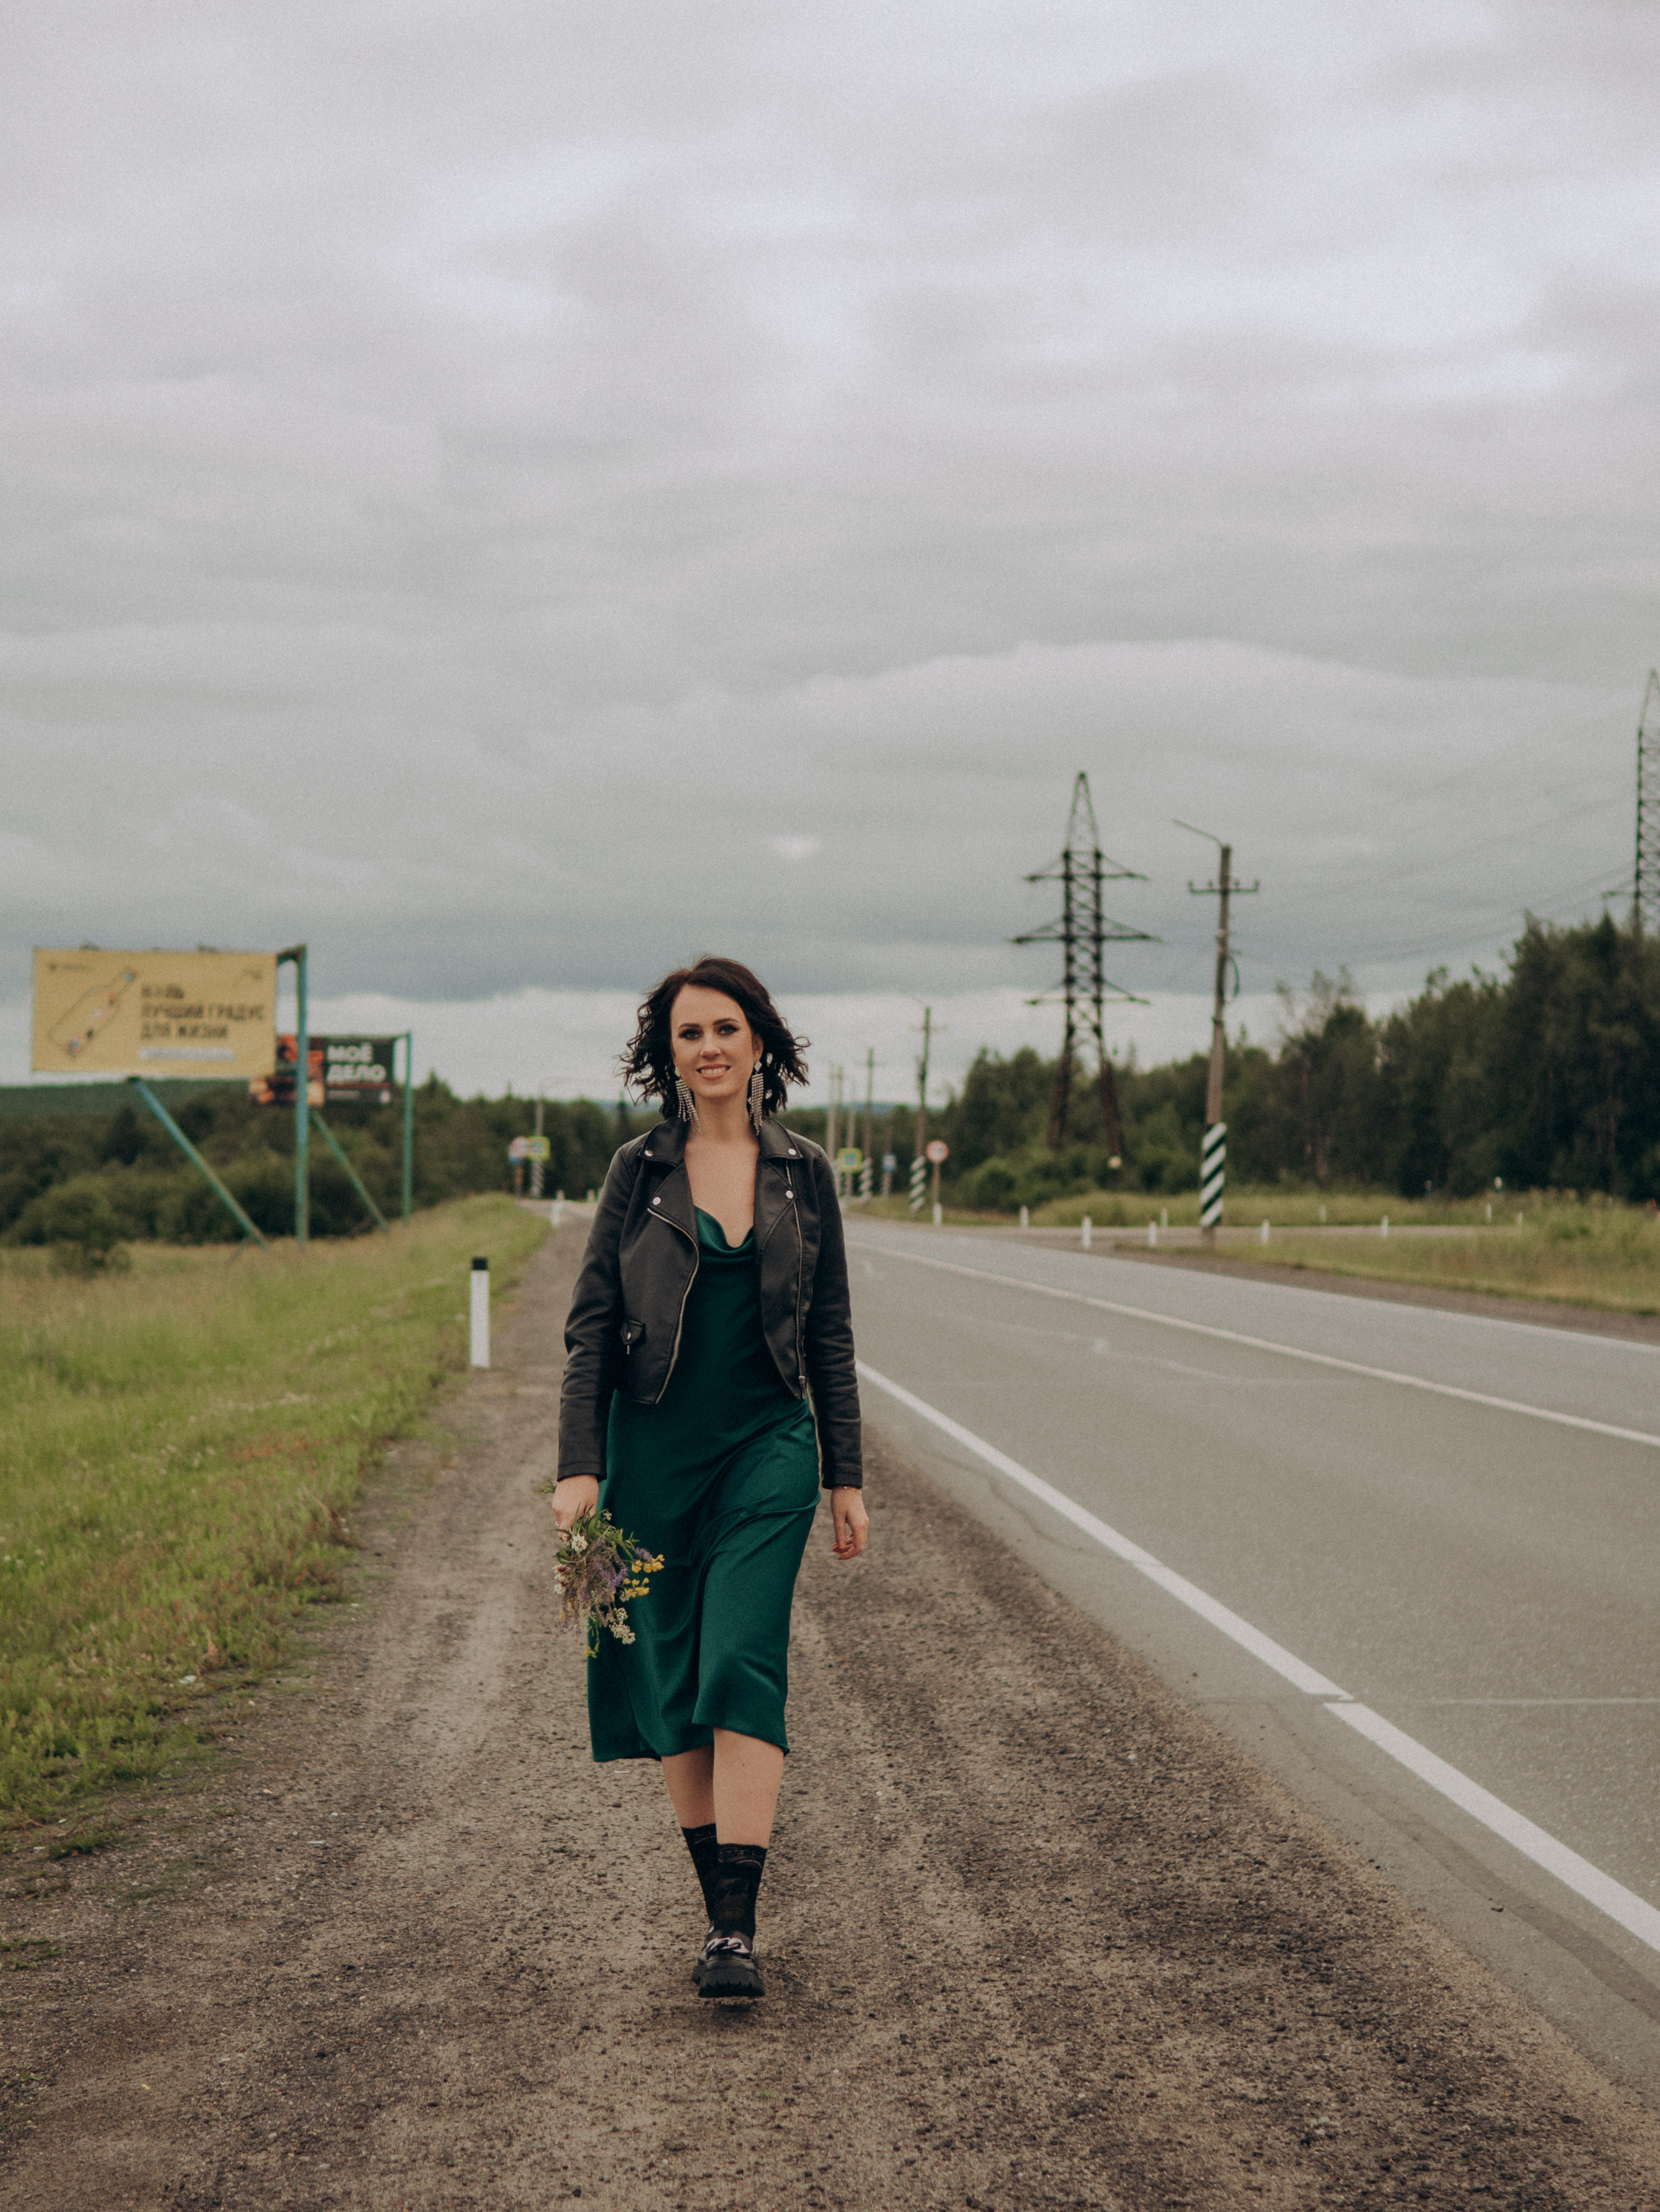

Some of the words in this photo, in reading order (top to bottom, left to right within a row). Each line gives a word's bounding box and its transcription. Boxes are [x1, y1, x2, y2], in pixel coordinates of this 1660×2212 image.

[208, 1004, 265, 1022] ГРАДУС
[140, 1023, 171, 1040] ДЛЯ
[176, 1024, 228, 1039] ЖИЗНИ
[326, 1064, 386, 1084] ДЕЛО
